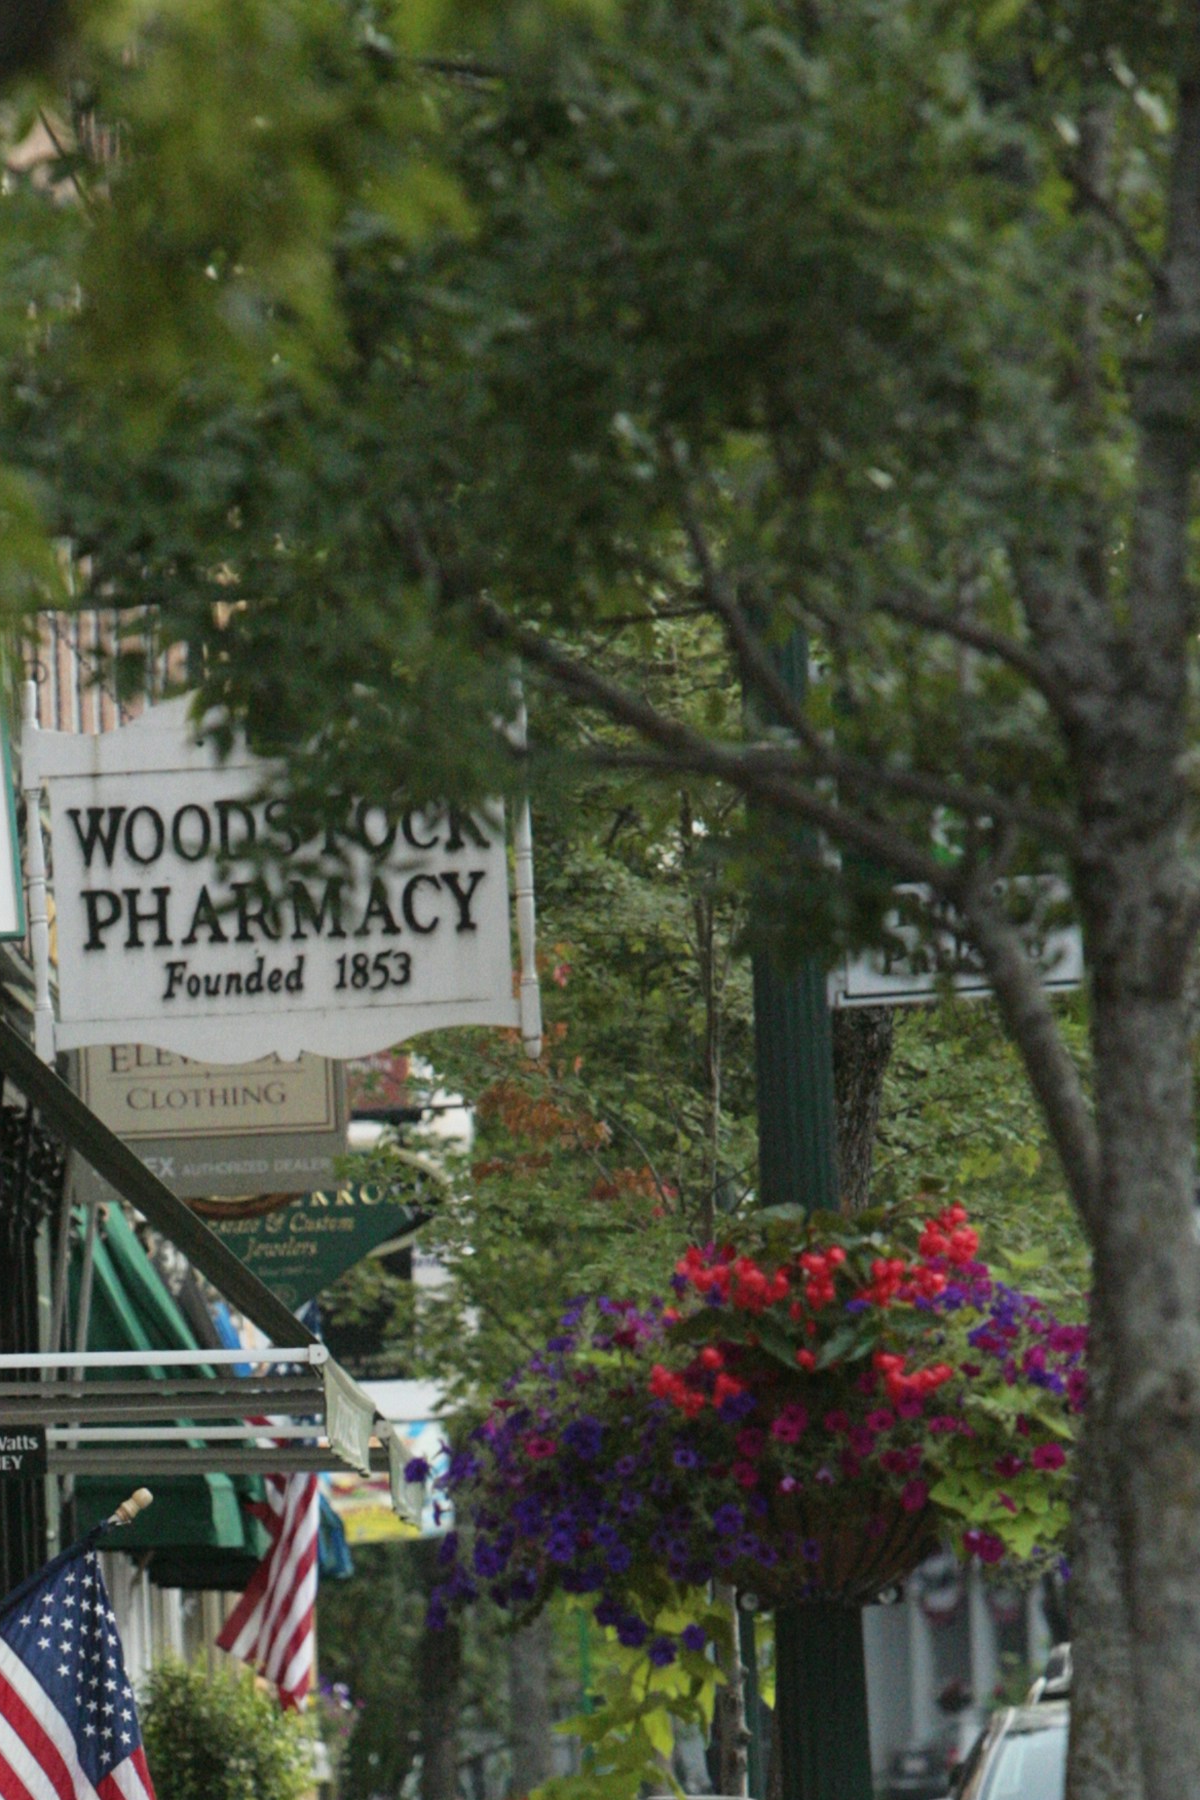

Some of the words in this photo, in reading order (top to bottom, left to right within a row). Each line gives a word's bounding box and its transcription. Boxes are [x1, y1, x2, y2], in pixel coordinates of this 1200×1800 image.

[80, 870, 486, 952] PHARMACY
[163, 954, 305, 999] Founded
[334, 950, 413, 991] 1853
[125, 1081, 287, 1112] CLOTHING
